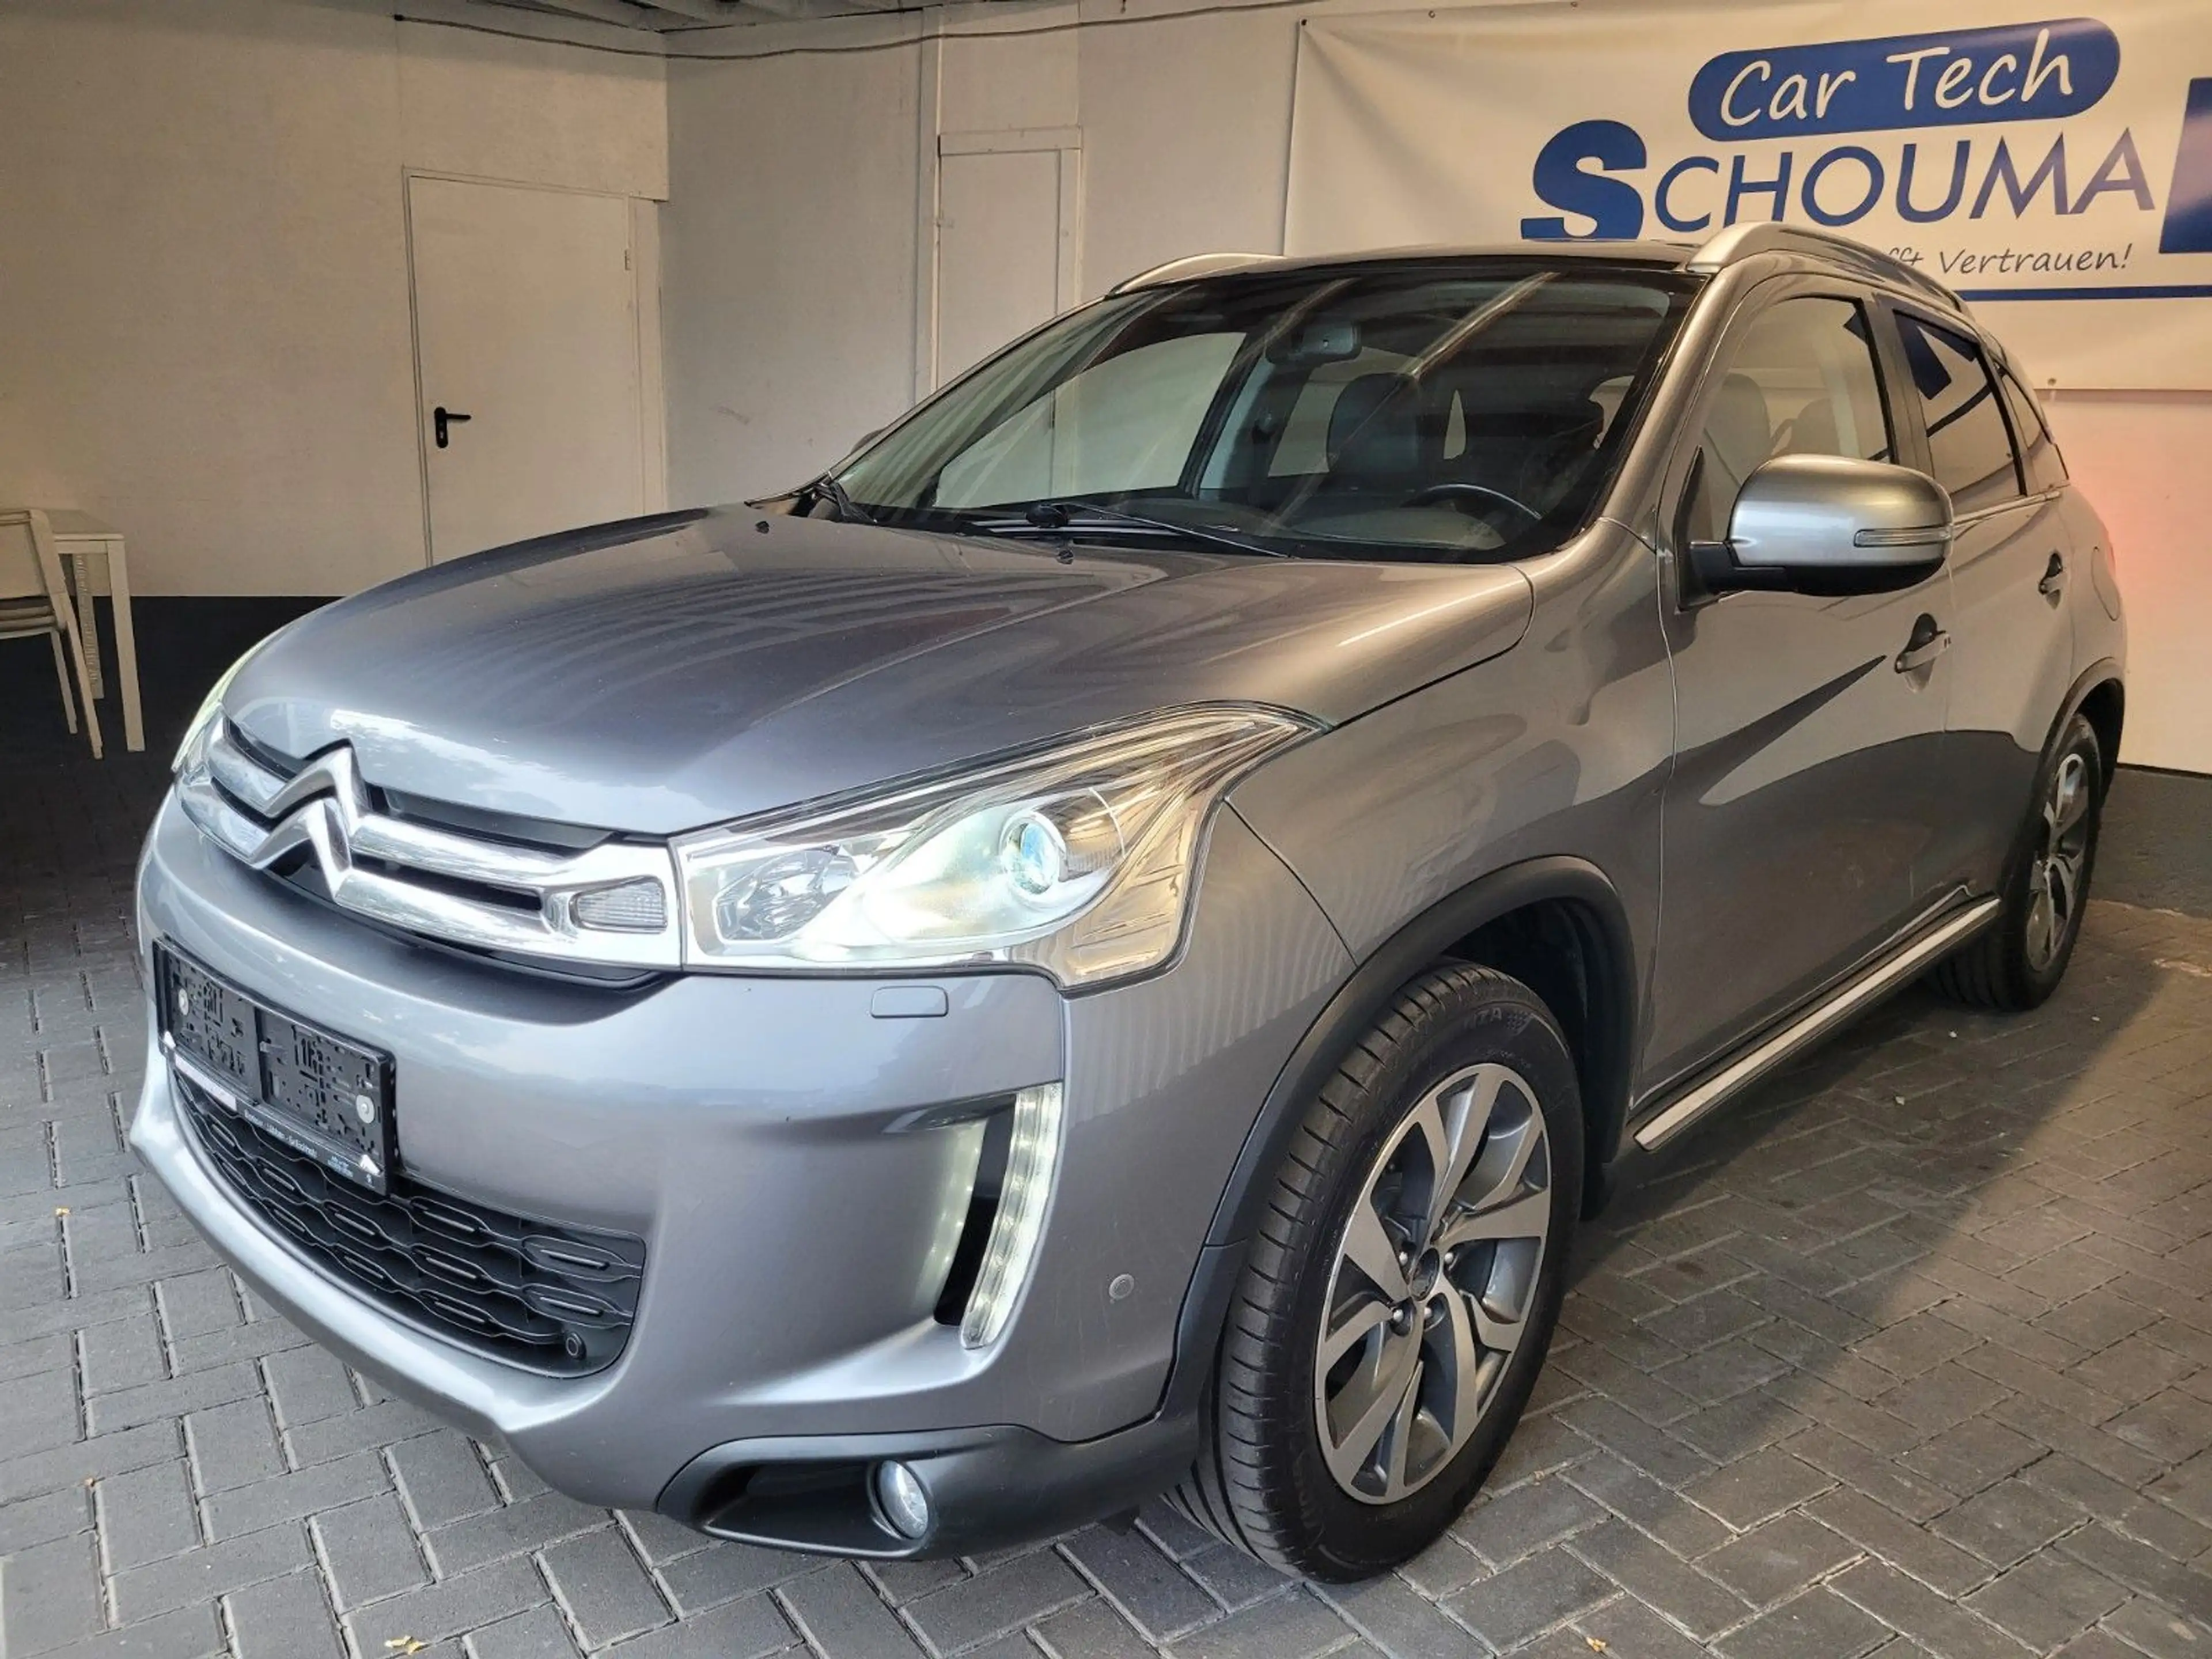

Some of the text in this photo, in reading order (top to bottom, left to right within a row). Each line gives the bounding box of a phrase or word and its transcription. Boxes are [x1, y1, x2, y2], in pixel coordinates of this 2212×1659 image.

[1721, 28, 2073, 127] Car Tech
[1521, 78, 2212, 253] SCHOUMA
[1939, 243, 2133, 274] Vertrauen!
